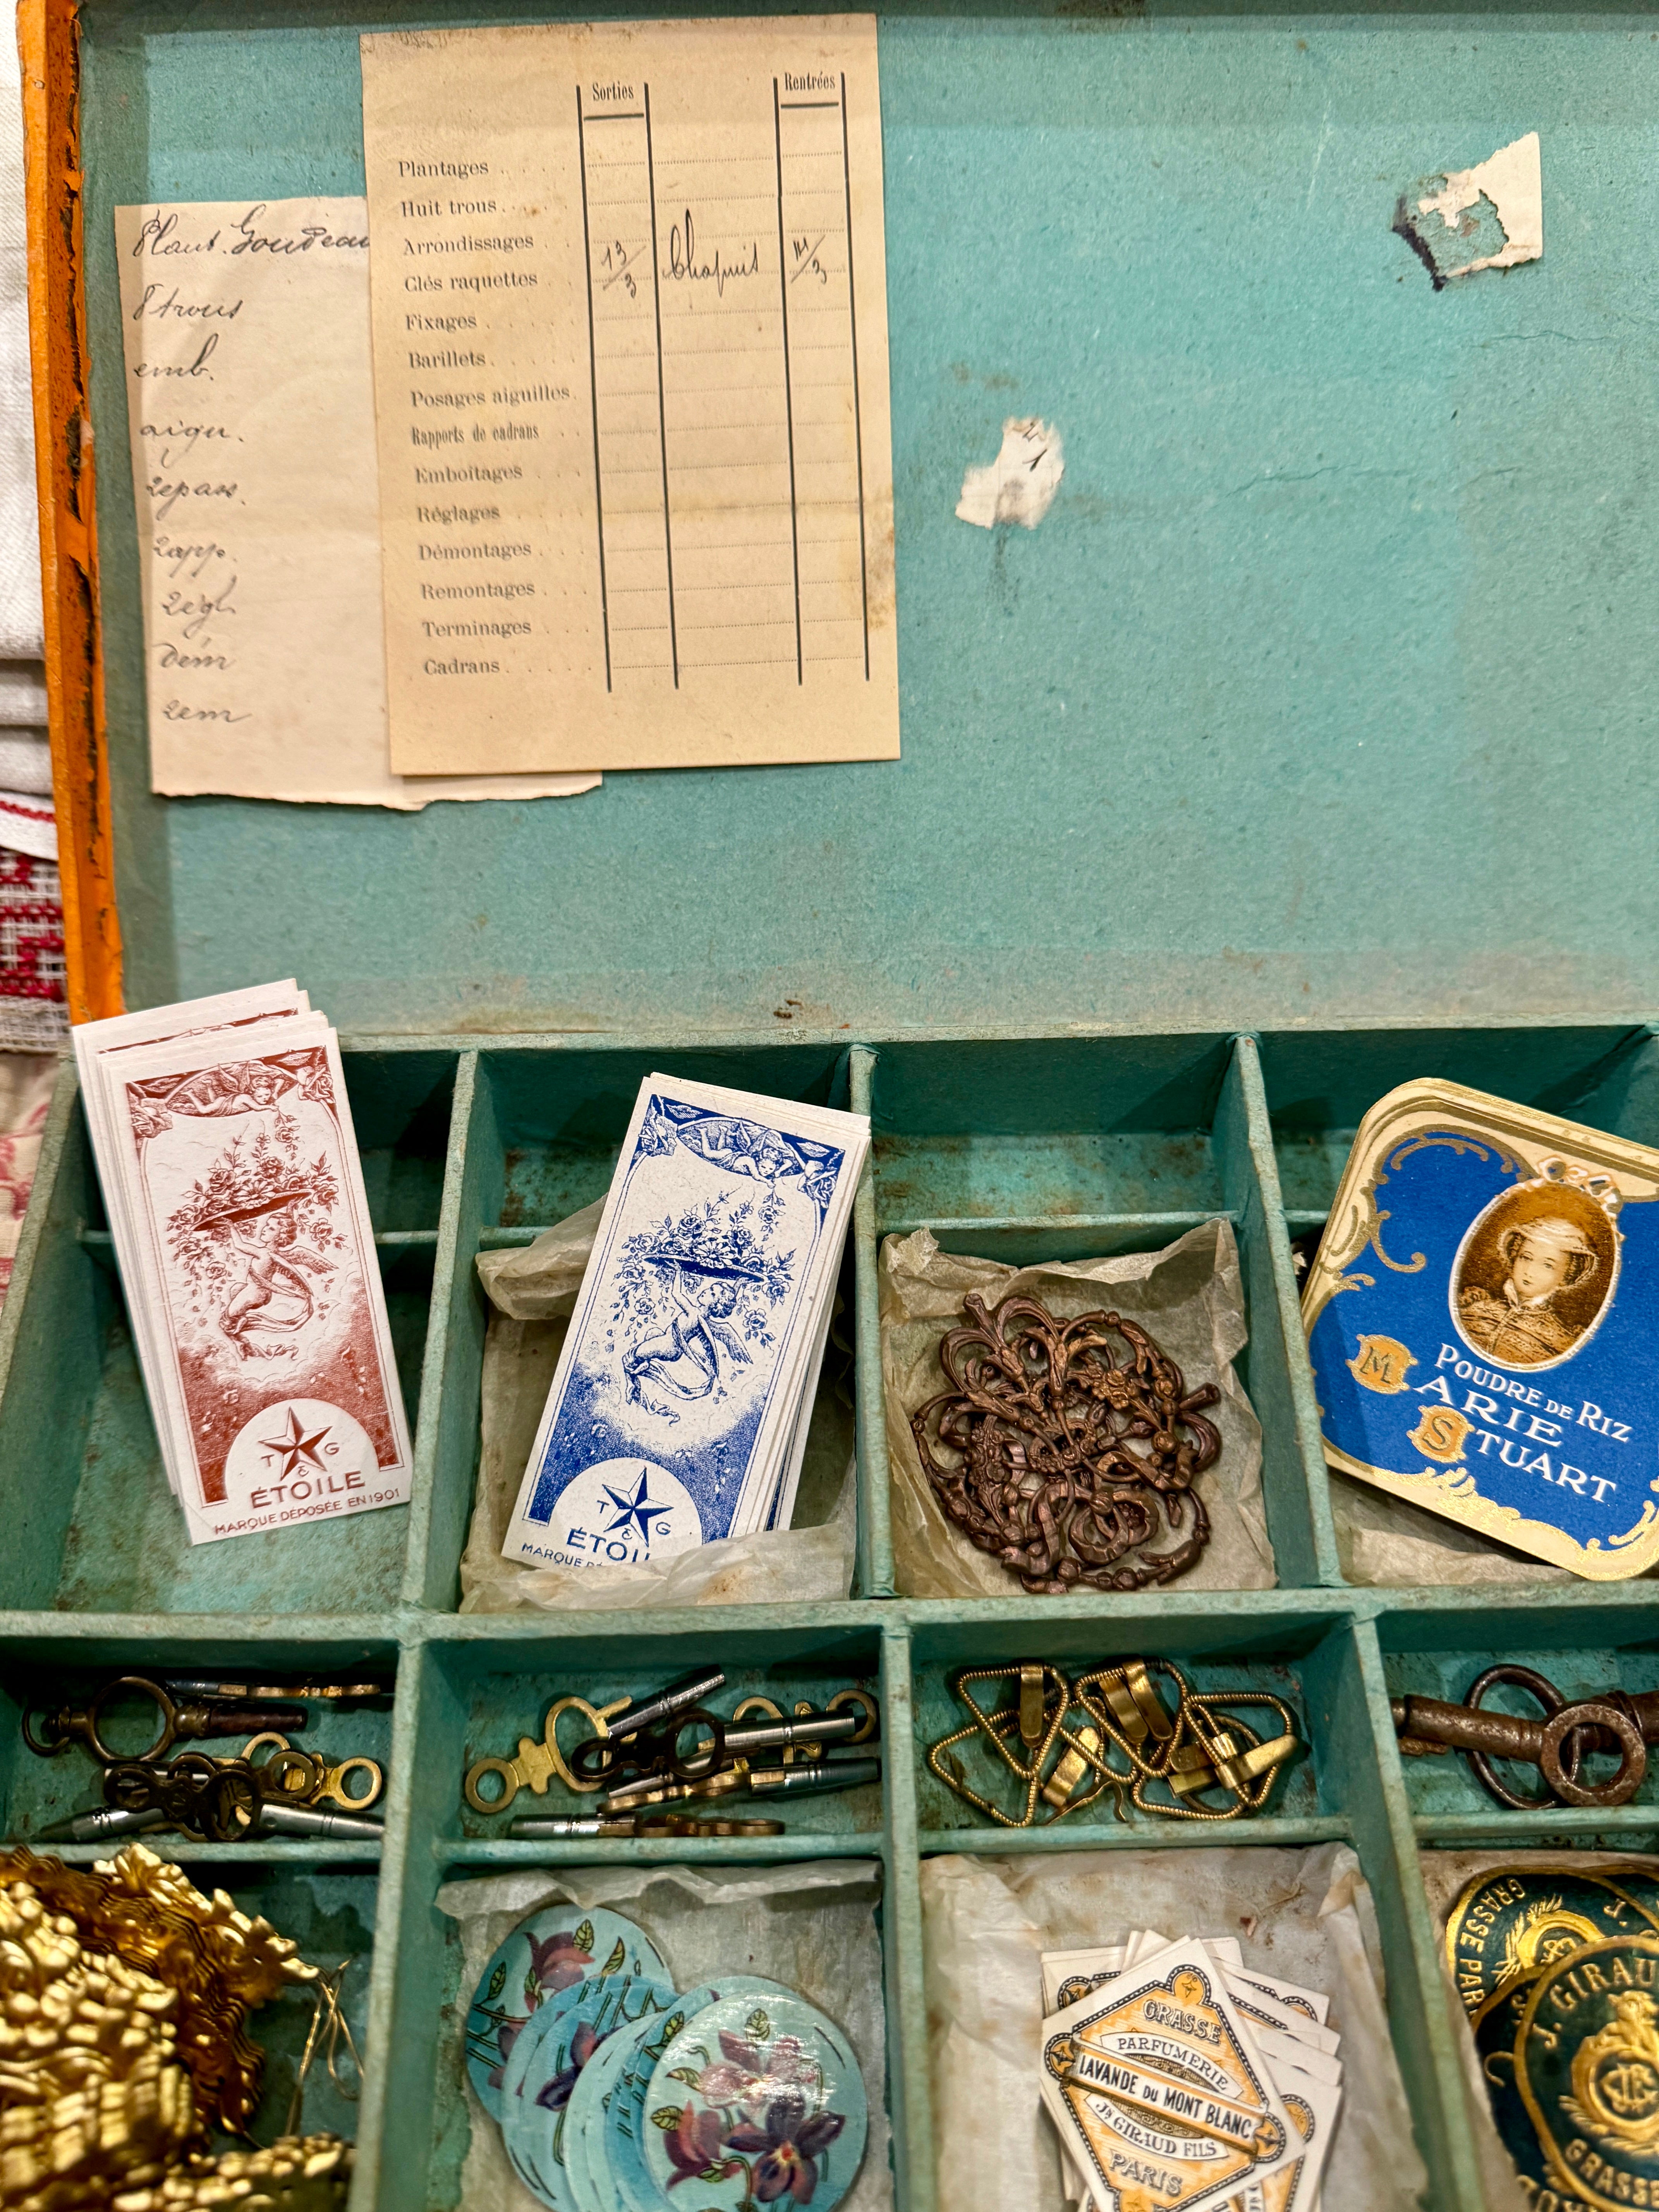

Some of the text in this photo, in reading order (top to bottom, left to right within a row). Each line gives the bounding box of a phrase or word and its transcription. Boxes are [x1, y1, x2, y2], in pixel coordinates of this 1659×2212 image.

[592, 82, 635, 101] Sorties
[784, 71, 836, 91] Rentrées
[398, 159, 489, 179] Plantages
[402, 199, 497, 217] Huit trous
[403, 233, 535, 255] Arrondissages
[404, 271, 538, 293] Clés raquettes
[405, 313, 478, 332] Fixages
[409, 350, 486, 369] Barillets
[410, 383, 570, 409] Posages aiguilles
[412, 421, 539, 450] Rapports de cadrans
[417, 505, 501, 525] Réglages
[419, 541, 532, 562] Démontages
[421, 580, 536, 601] Remontages
[422, 619, 532, 639] Terminages
[424, 658, 500, 677] Cadrans
[1434, 1342, 1543, 1408] POUDRE
[1575, 1400, 1634, 1443] RIZ
[250, 1470, 366, 1509] ÉTOILE
[214, 1488, 400, 1535] MARQUE DÉPOSÉE EN 1901
[522, 1542, 582, 1567] MARQUE
[567, 1526, 651, 1563] ÉTOI
[1460, 1877, 1526, 1953] GRASSE
[1143, 1999, 1222, 2045] GRASSE
[1117, 2037, 1229, 2091] PARFUMERIE
[1079, 2054, 1254, 2139] LAVANDE DU MONT BLANC
[1113, 2117, 1177, 2154] GIRAUD
[1183, 2141, 1217, 2157] FILS
[1109, 2151, 1183, 2197] PARIS
